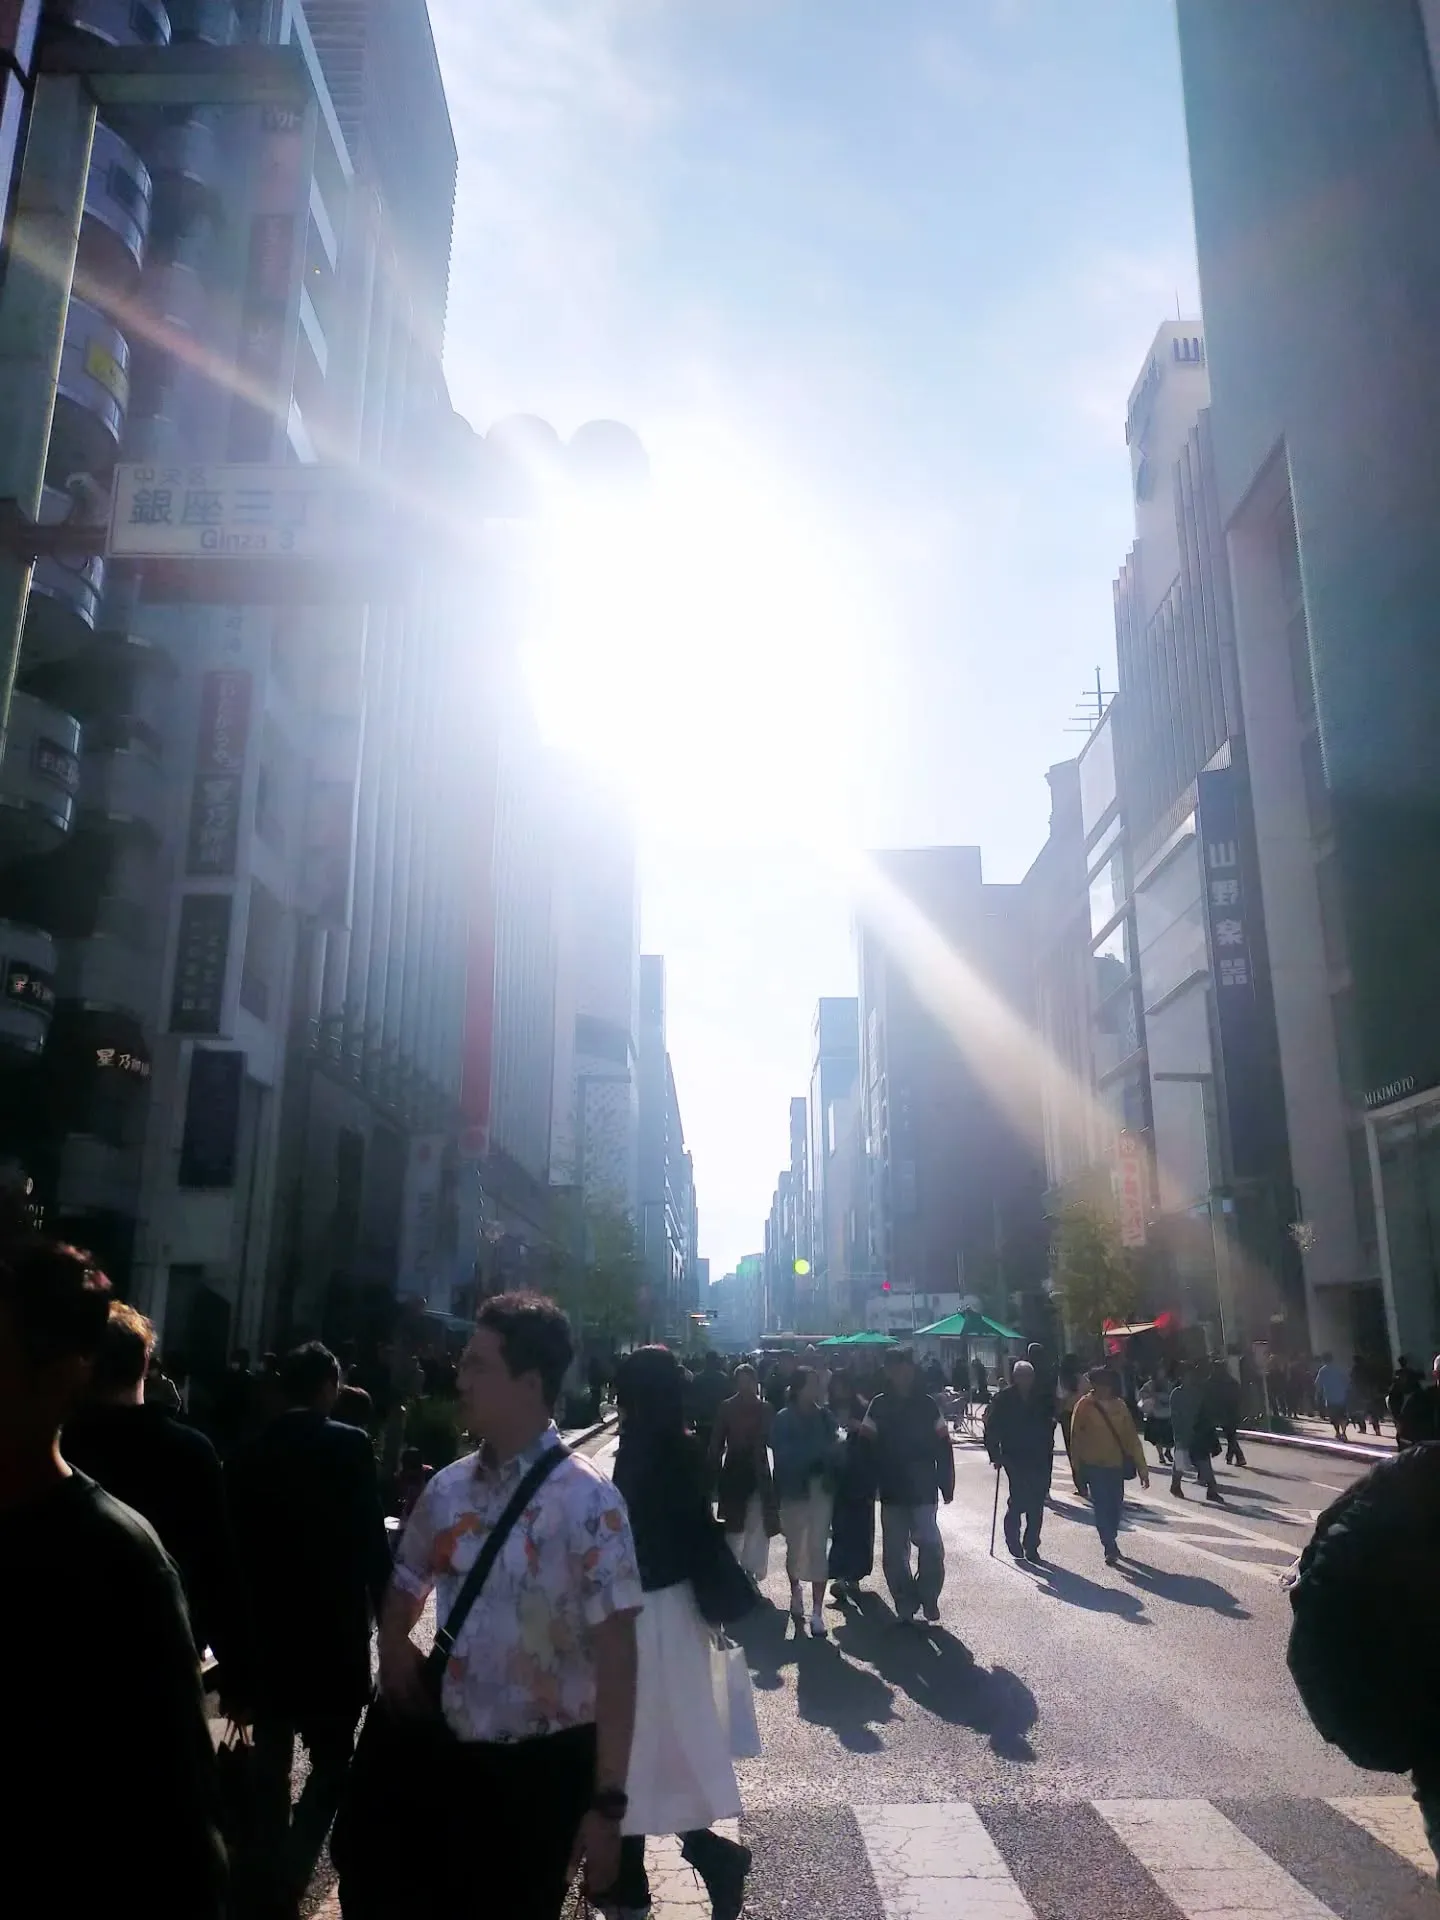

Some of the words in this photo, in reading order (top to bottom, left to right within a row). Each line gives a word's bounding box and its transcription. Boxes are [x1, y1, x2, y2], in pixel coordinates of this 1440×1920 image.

[128, 488, 366, 526] 銀座三丁
[201, 530, 268, 550] Ginza
[278, 530, 297, 550] 3
[1208, 840, 1250, 986] 山野楽器
[1364, 1075, 1414, 1105] MIKIMOTO
